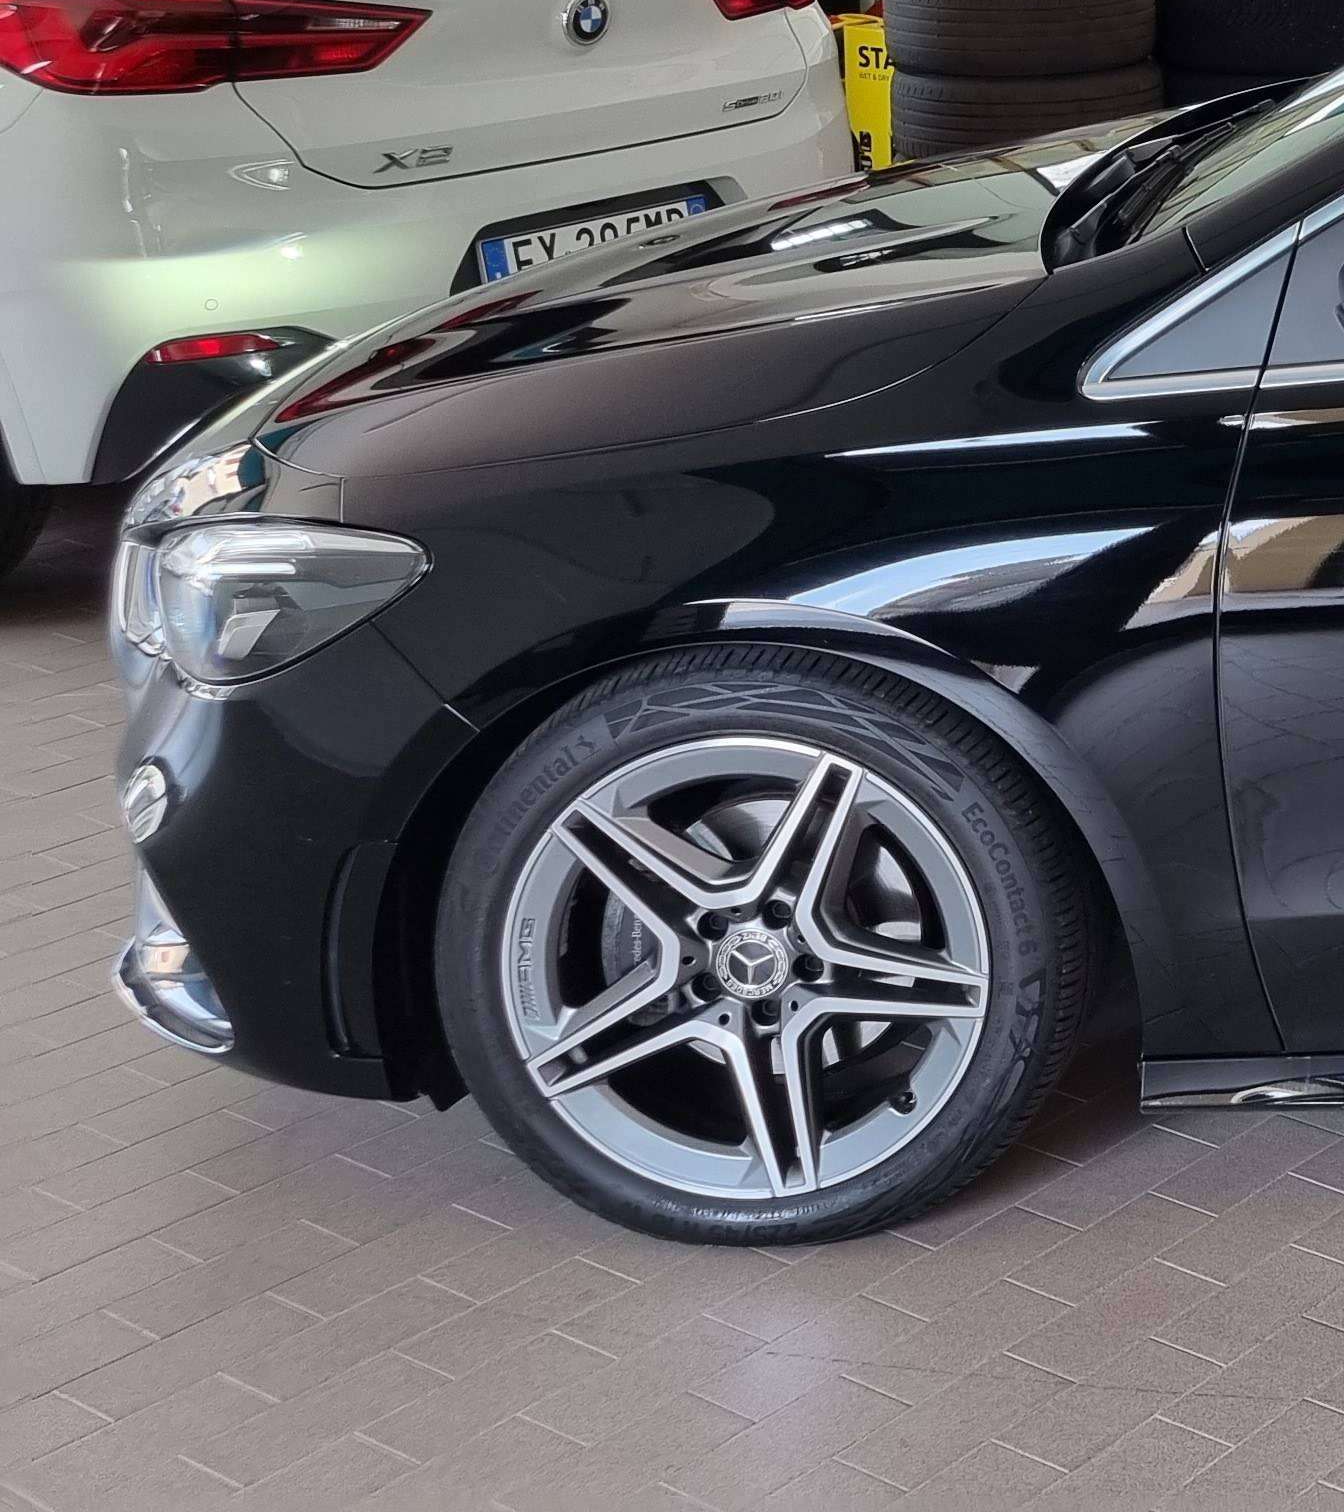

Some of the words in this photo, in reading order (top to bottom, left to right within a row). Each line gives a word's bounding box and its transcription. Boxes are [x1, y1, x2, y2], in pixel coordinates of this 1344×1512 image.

[373, 146, 453, 174] X2
[961, 802, 1028, 936] EcoContact
[1018, 940, 1038, 956] 6
[517, 918, 536, 982] AMG
